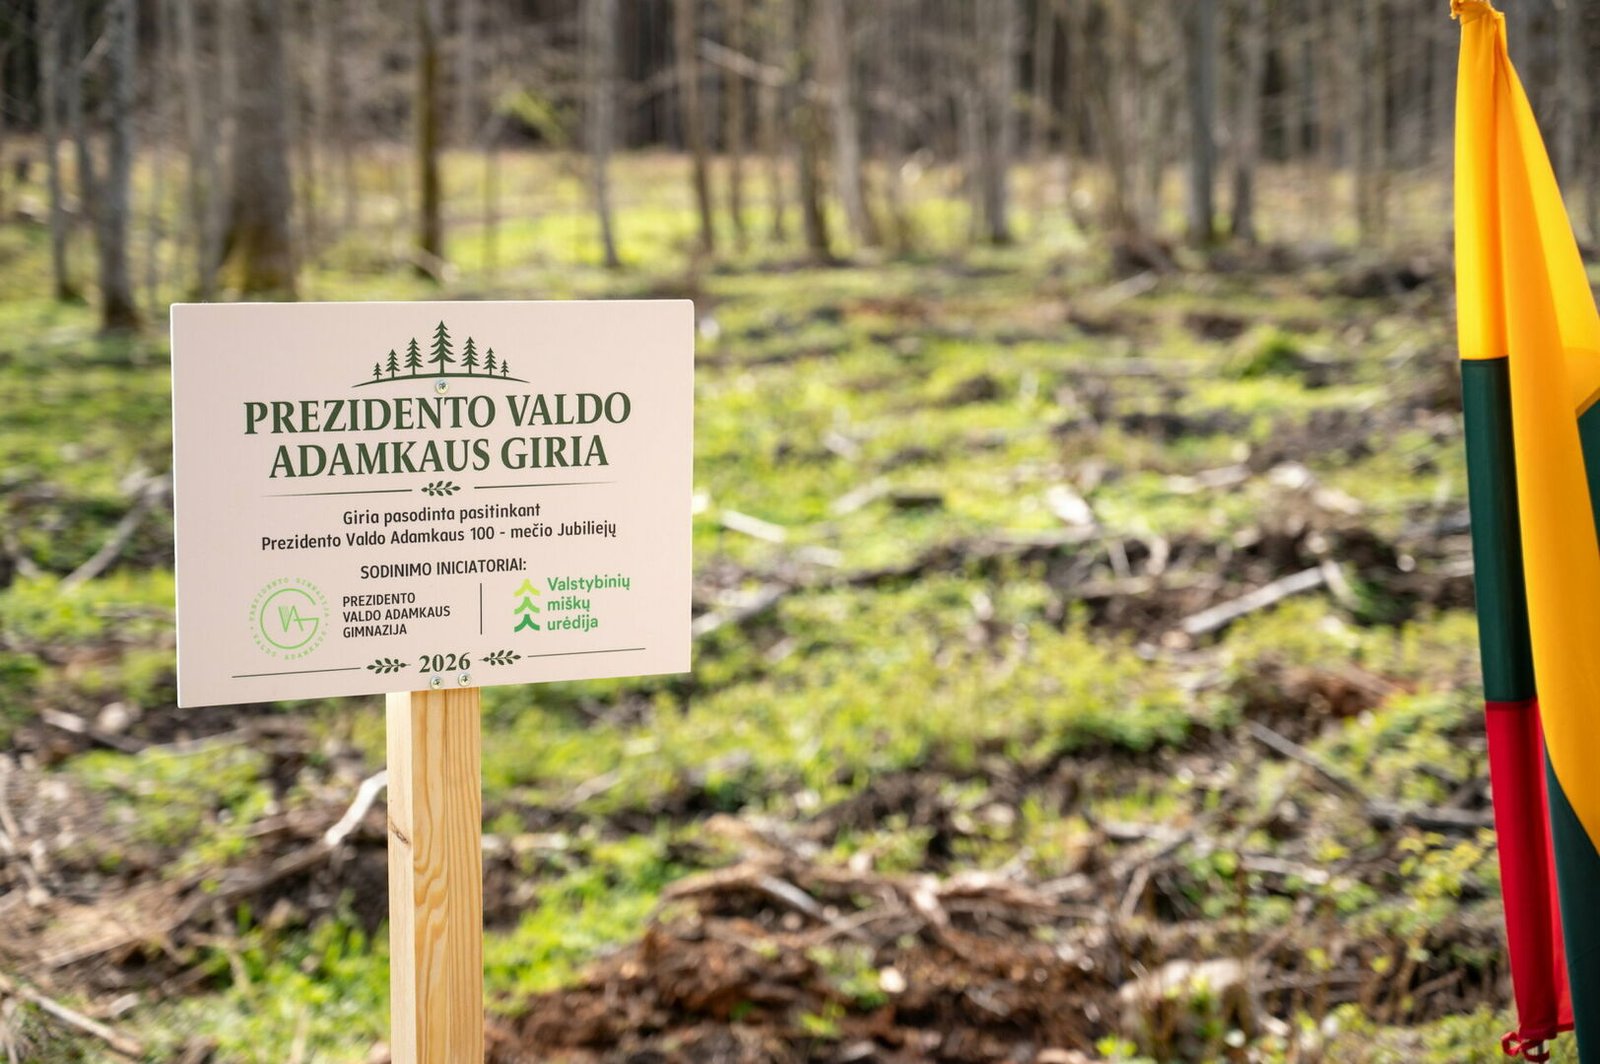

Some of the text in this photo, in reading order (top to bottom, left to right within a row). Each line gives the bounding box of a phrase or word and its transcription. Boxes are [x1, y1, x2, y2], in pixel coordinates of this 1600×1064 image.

[243, 391, 632, 435] PREZIDENTO VALDO
[268, 434, 610, 479] ADAMKAUS GIRIA
[342, 502, 541, 526] Giria pasodinta pasitinkant
[261, 533, 342, 551] Prezidento
[346, 530, 386, 547] Valdo
[390, 527, 465, 545] Adamkaus
[469, 525, 495, 541] 100
[510, 522, 553, 539] mečio
[557, 520, 617, 539] Jubiliejų
[360, 558, 527, 580] SODINIMO INICIATORIAI:
[547, 573, 631, 593] Valstybinių
[342, 592, 416, 608] PREZIDENTO
[547, 595, 591, 613] miškų
[342, 605, 451, 623] VALDO ADAMKAUS
[547, 614, 599, 632] urėdija
[342, 623, 408, 639] GIMNAZIJA
[418, 652, 471, 674] 2026
